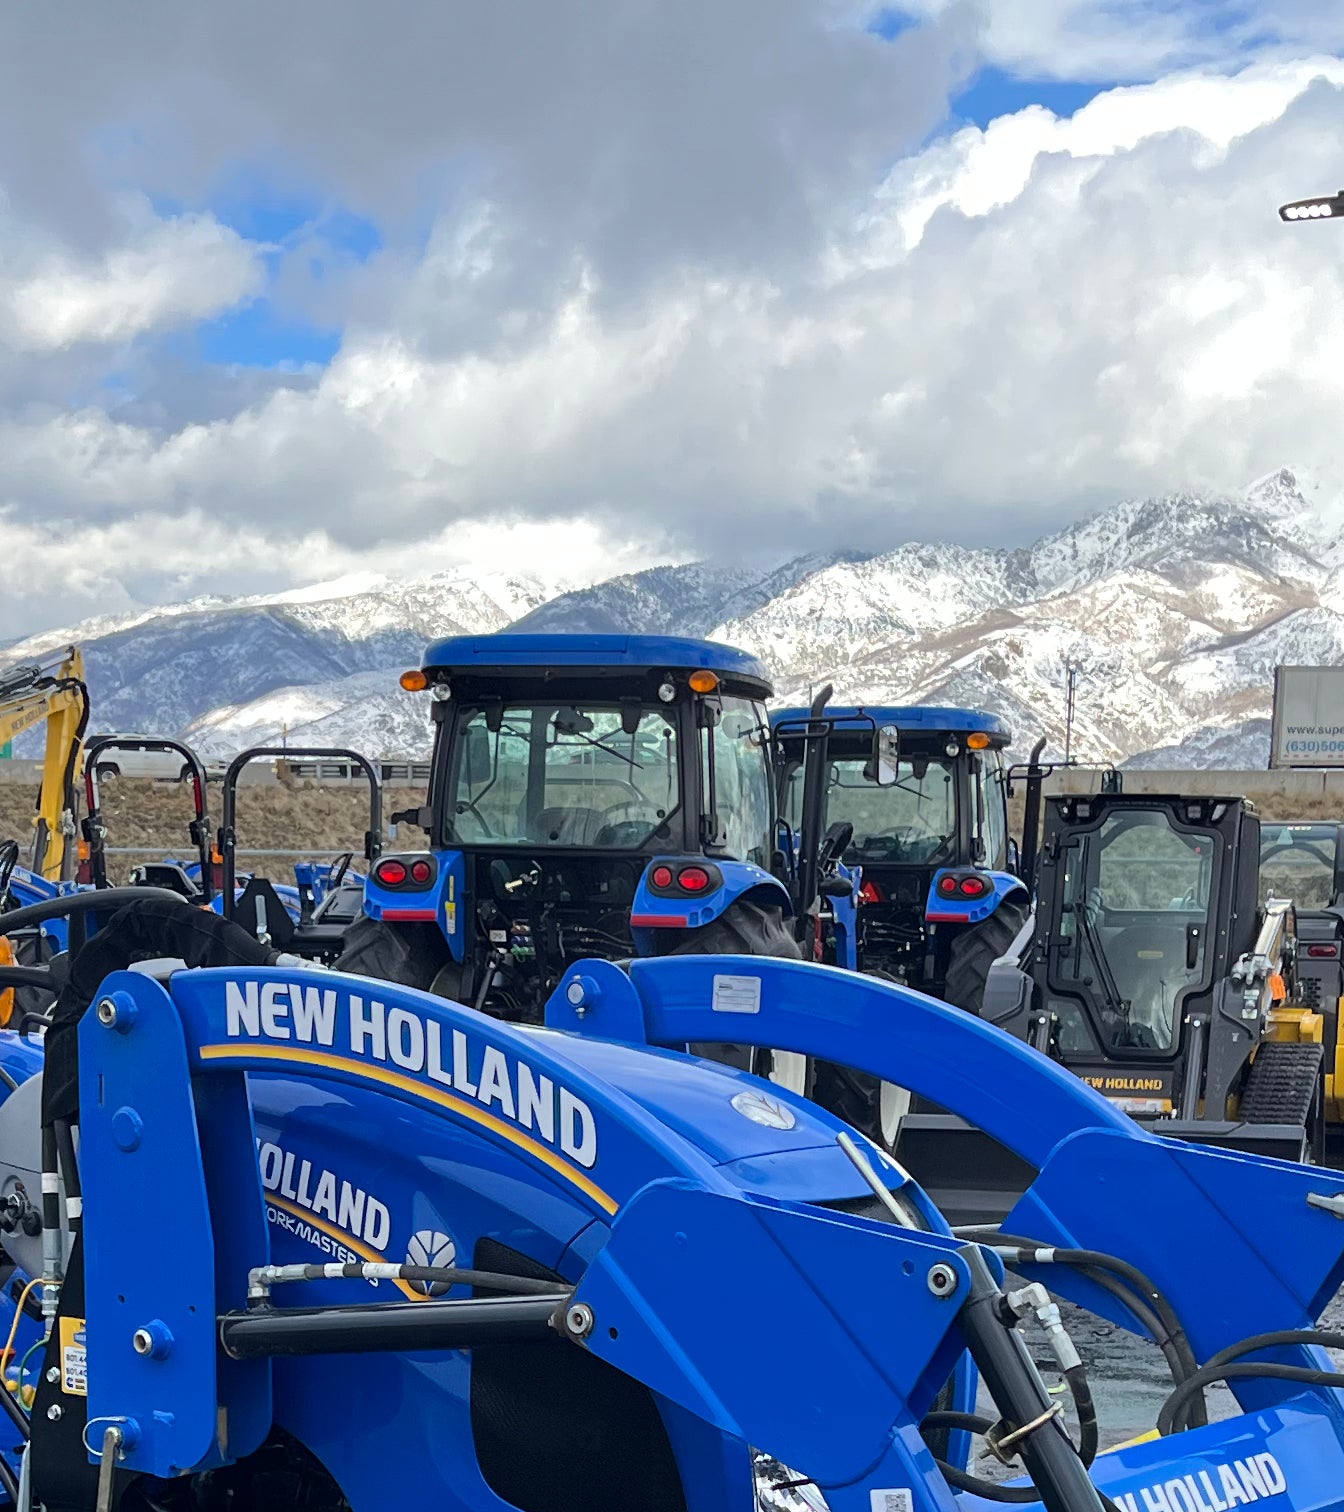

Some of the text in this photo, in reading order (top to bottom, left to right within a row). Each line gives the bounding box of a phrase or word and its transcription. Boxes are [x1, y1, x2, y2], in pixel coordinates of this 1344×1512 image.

[226, 981, 598, 1169] NEW HOLLAND
[1105, 1078, 1163, 1090] HOLLAND
[256, 1137, 391, 1251] OLLAND
[265, 1204, 357, 1265] ORKMASTER
